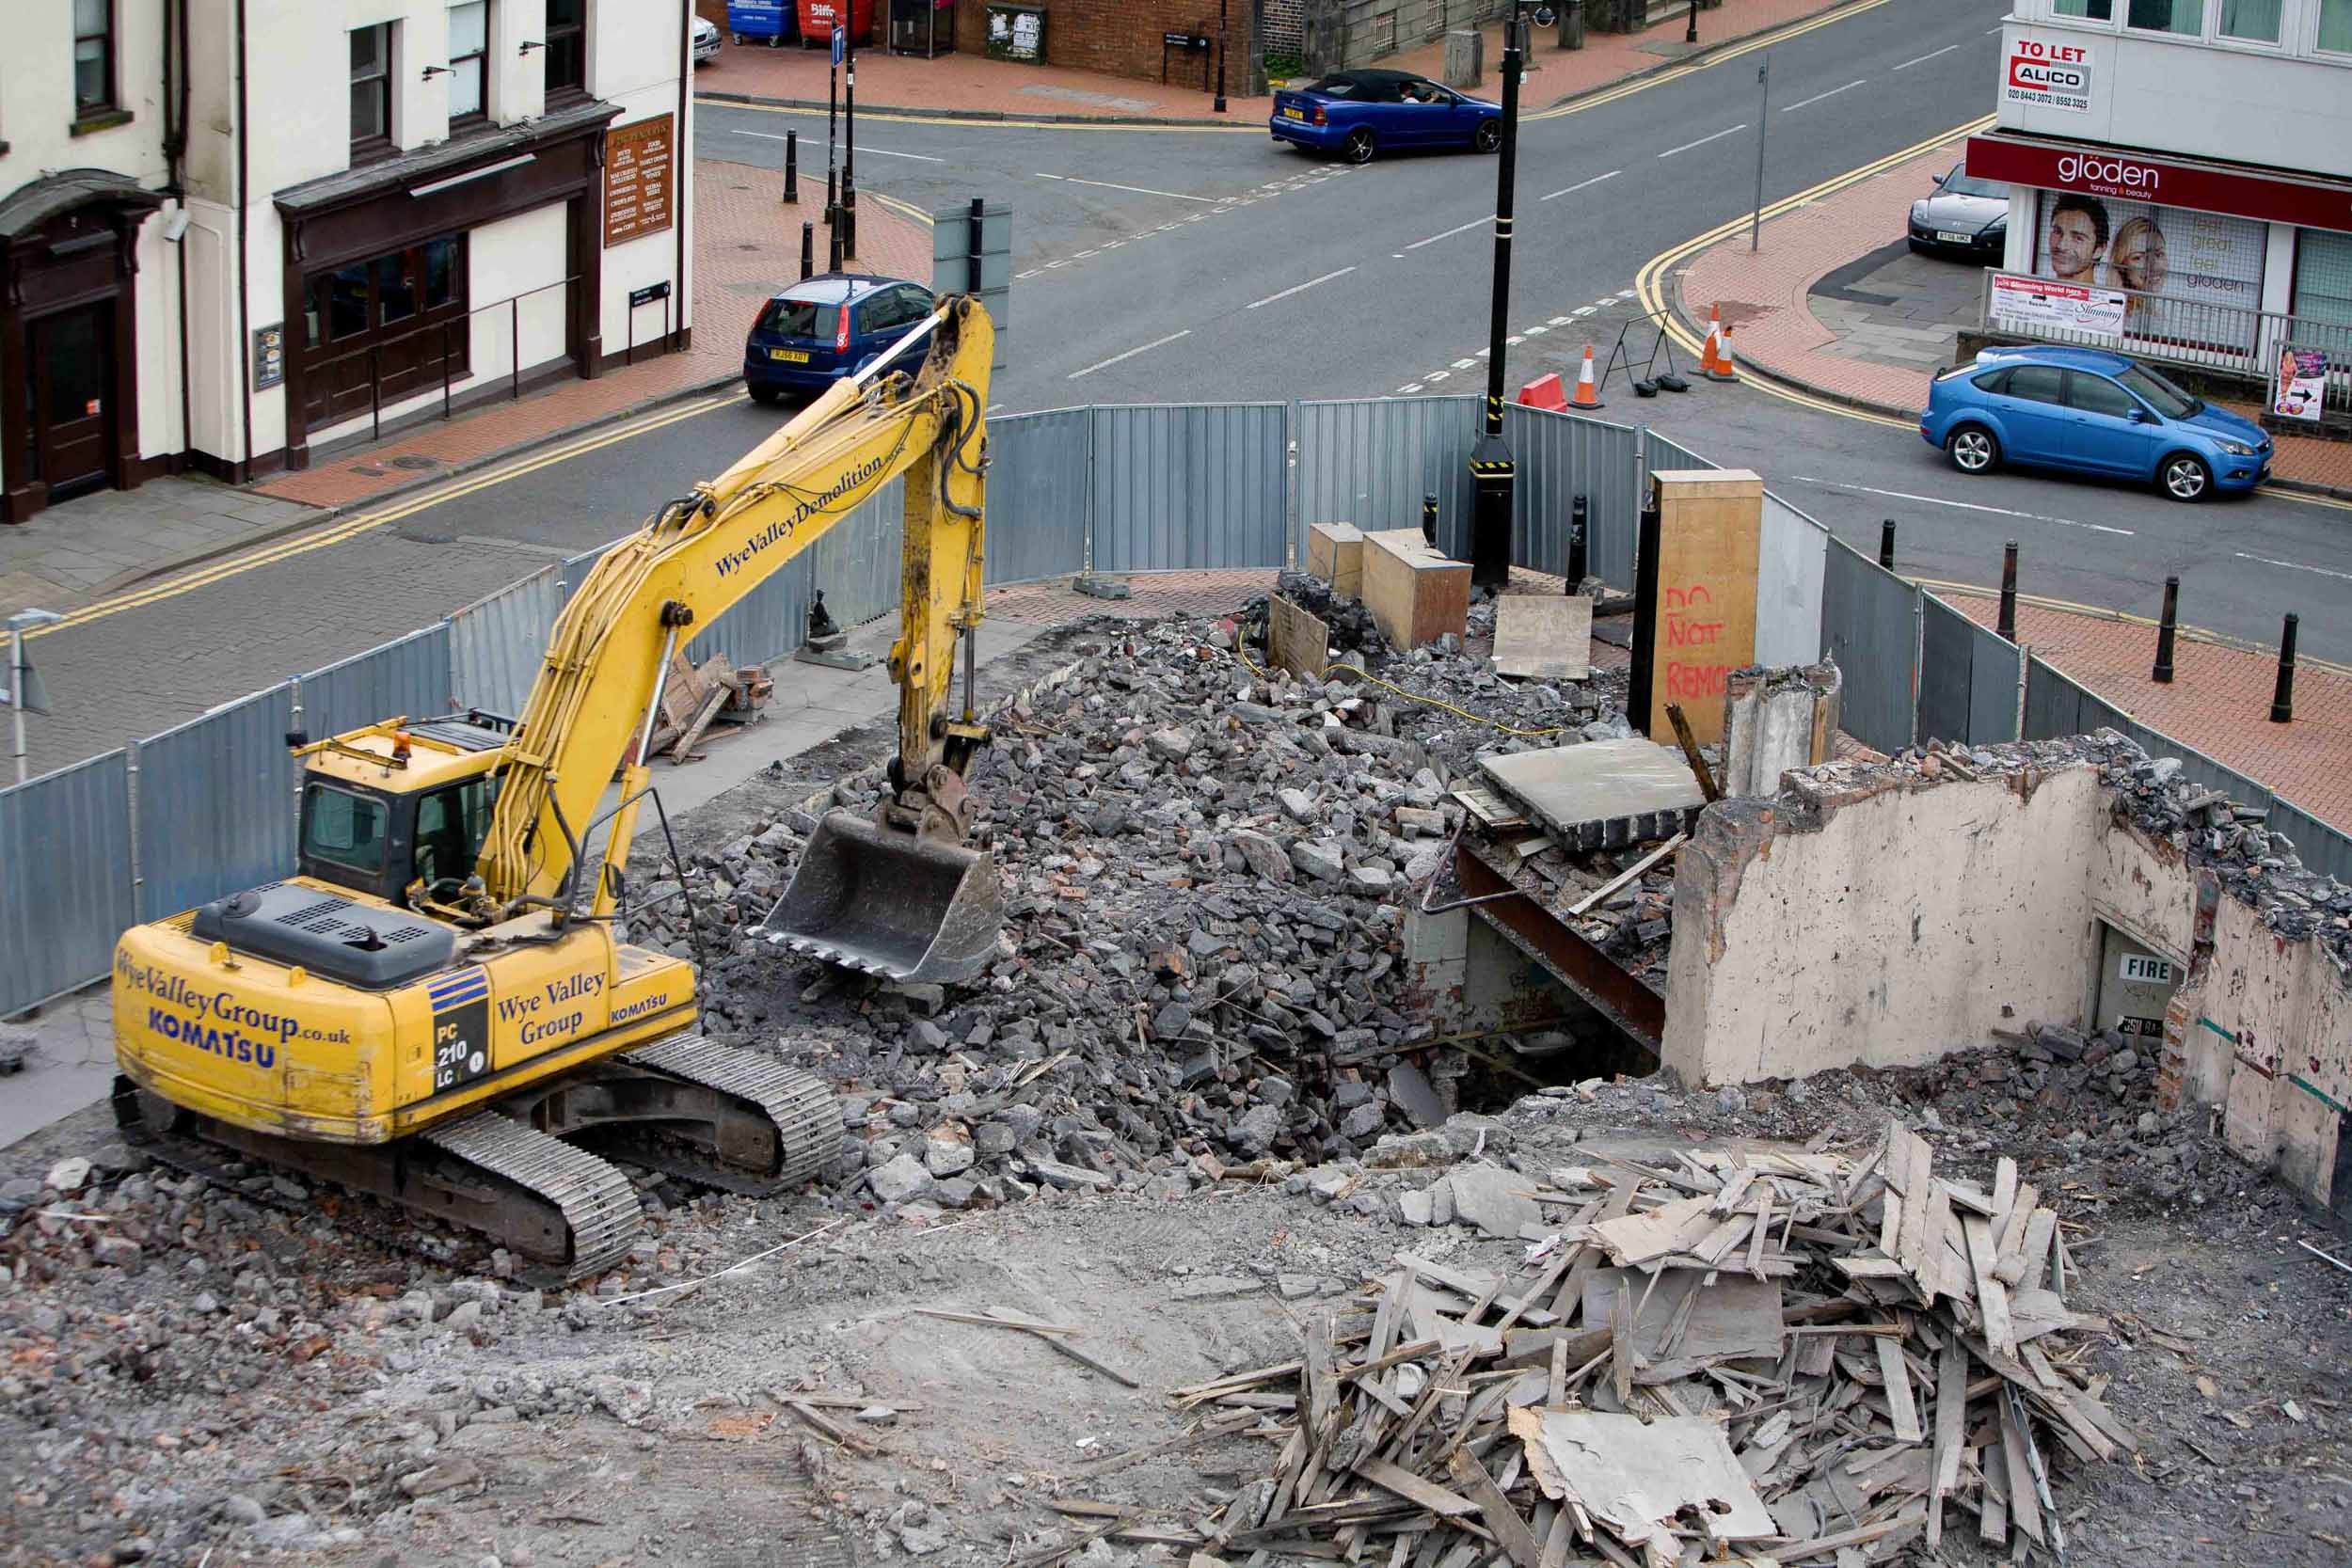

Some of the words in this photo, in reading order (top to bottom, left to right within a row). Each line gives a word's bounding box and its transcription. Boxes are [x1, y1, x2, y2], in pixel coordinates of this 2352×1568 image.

[2018, 40, 2043, 57] TO
[2050, 45, 2086, 63] LET
[2020, 68, 2080, 87] ALICO
[2008, 89, 2019, 100] 020
[2037, 94, 2052, 104] 3072
[2090, 183, 2118, 195] tanning
[2125, 188, 2153, 199] beauty
[2044, 283, 2065, 293] World
[2074, 302, 2122, 324] Slimming
[1666, 613, 1724, 647] NOT
[2127, 958, 2169, 980] FIRE
[498, 994, 541, 1024] Wye
[546, 971, 607, 1006] Valley
[611, 992, 667, 1022] KOMATSU
[148, 1006, 275, 1069] KOMATSU
[437, 1022, 458, 1044] PC
[520, 1010, 582, 1046] Group
[437, 1039, 467, 1067] 210
[437, 1069, 453, 1088] LC
